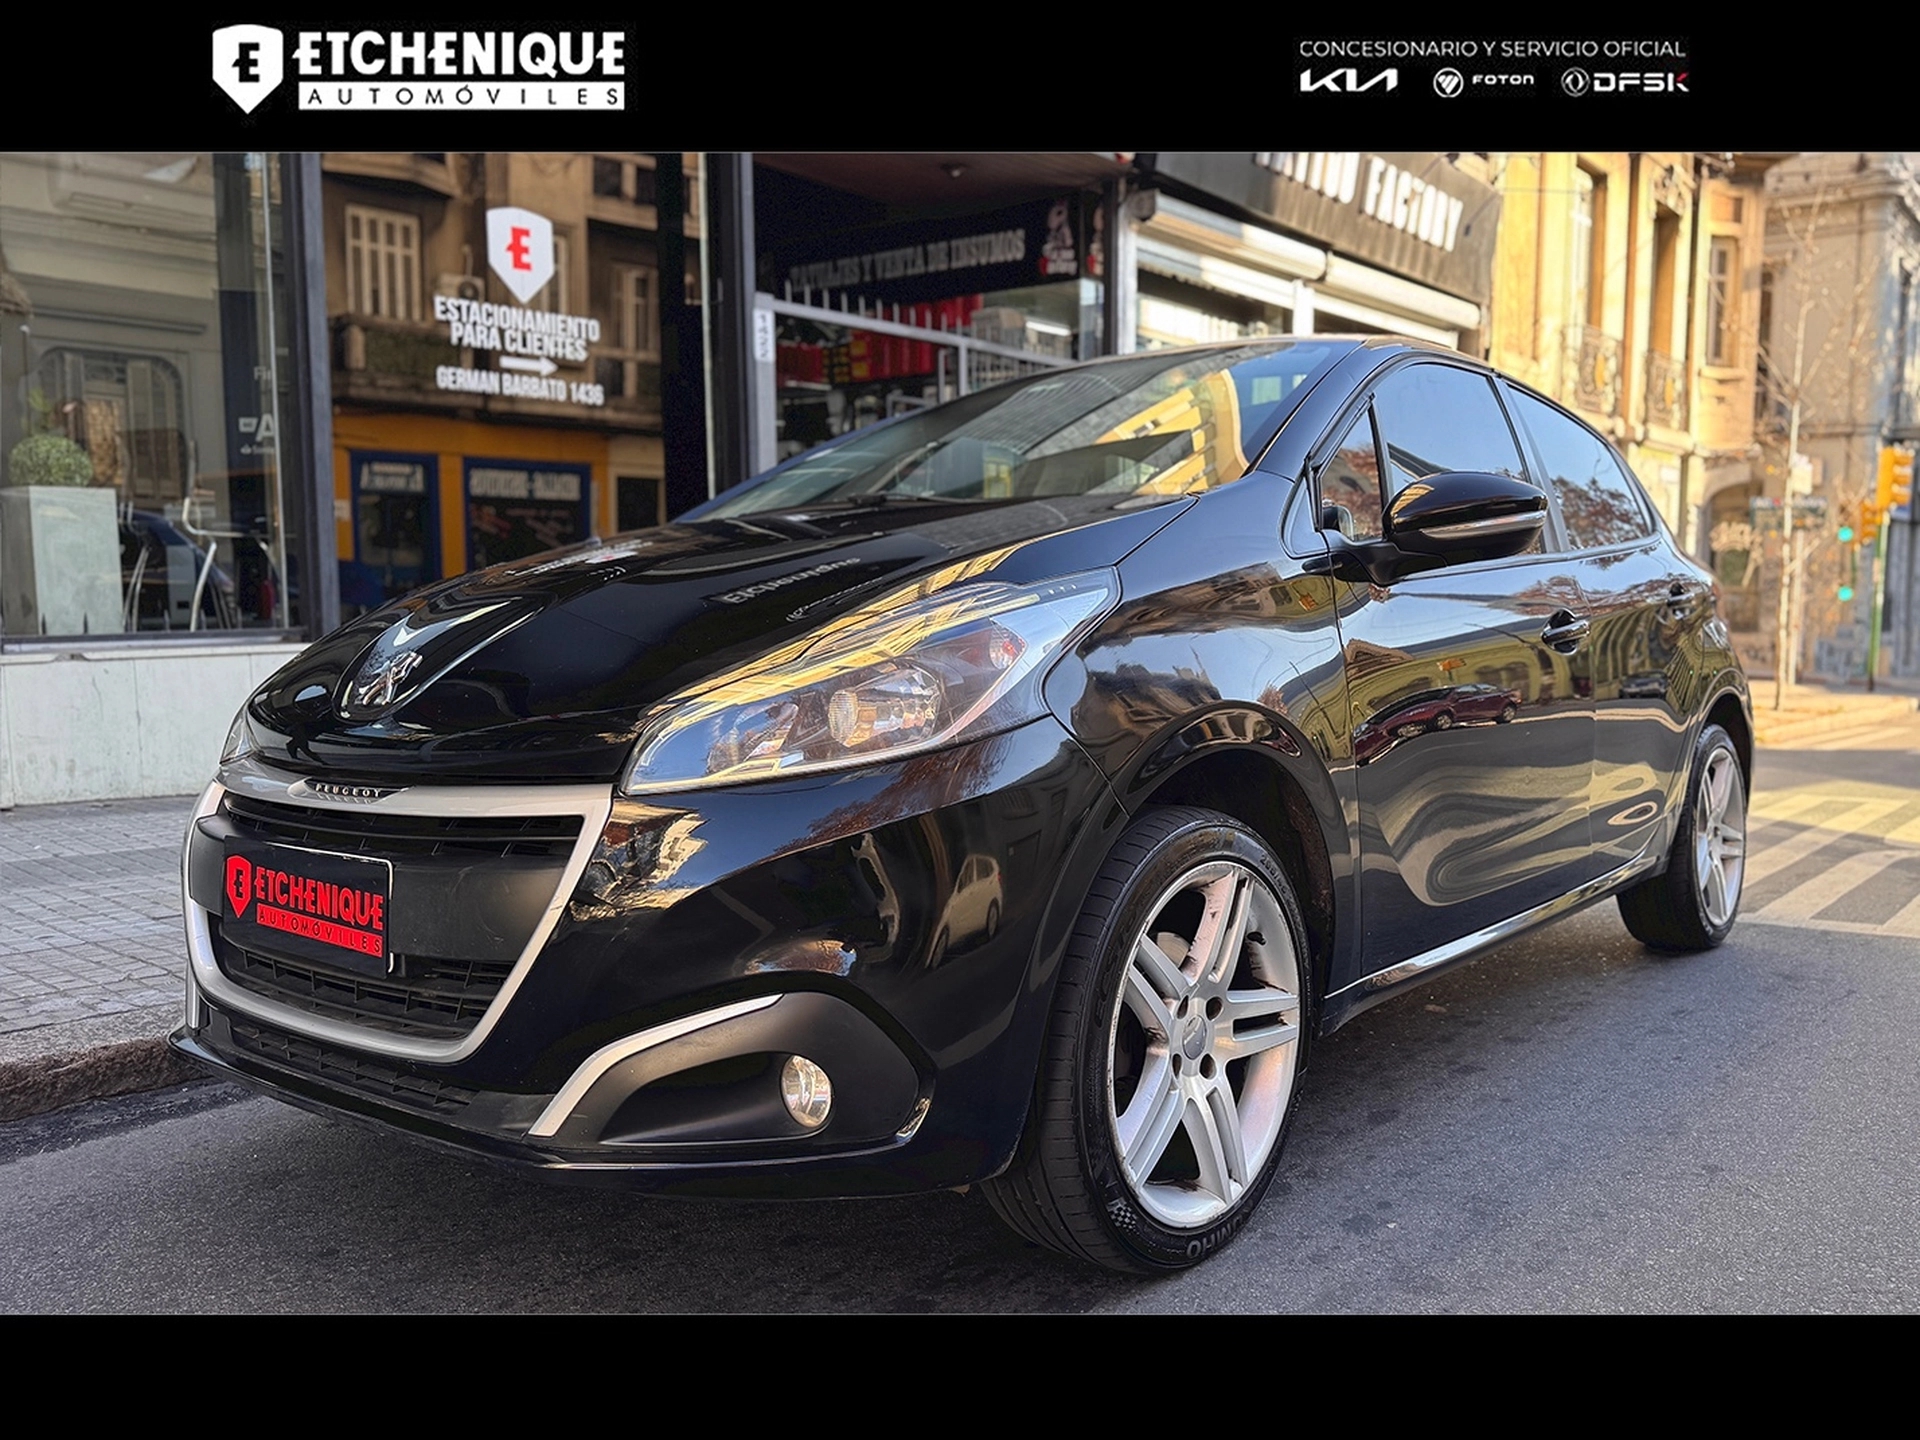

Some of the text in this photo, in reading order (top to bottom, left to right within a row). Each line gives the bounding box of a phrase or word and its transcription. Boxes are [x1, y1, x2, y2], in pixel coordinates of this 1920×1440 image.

[1364, 155, 1464, 253] FACTORY
[434, 295, 600, 342] ESTACIONAMIENTO
[451, 322, 588, 362] PARA CLIENTES
[436, 366, 500, 395] GERMAN
[315, 783, 383, 798] PEUGEOT
[254, 866, 384, 931] ETCHENIQUE
[258, 911, 382, 953] AUTOMÓVILES
